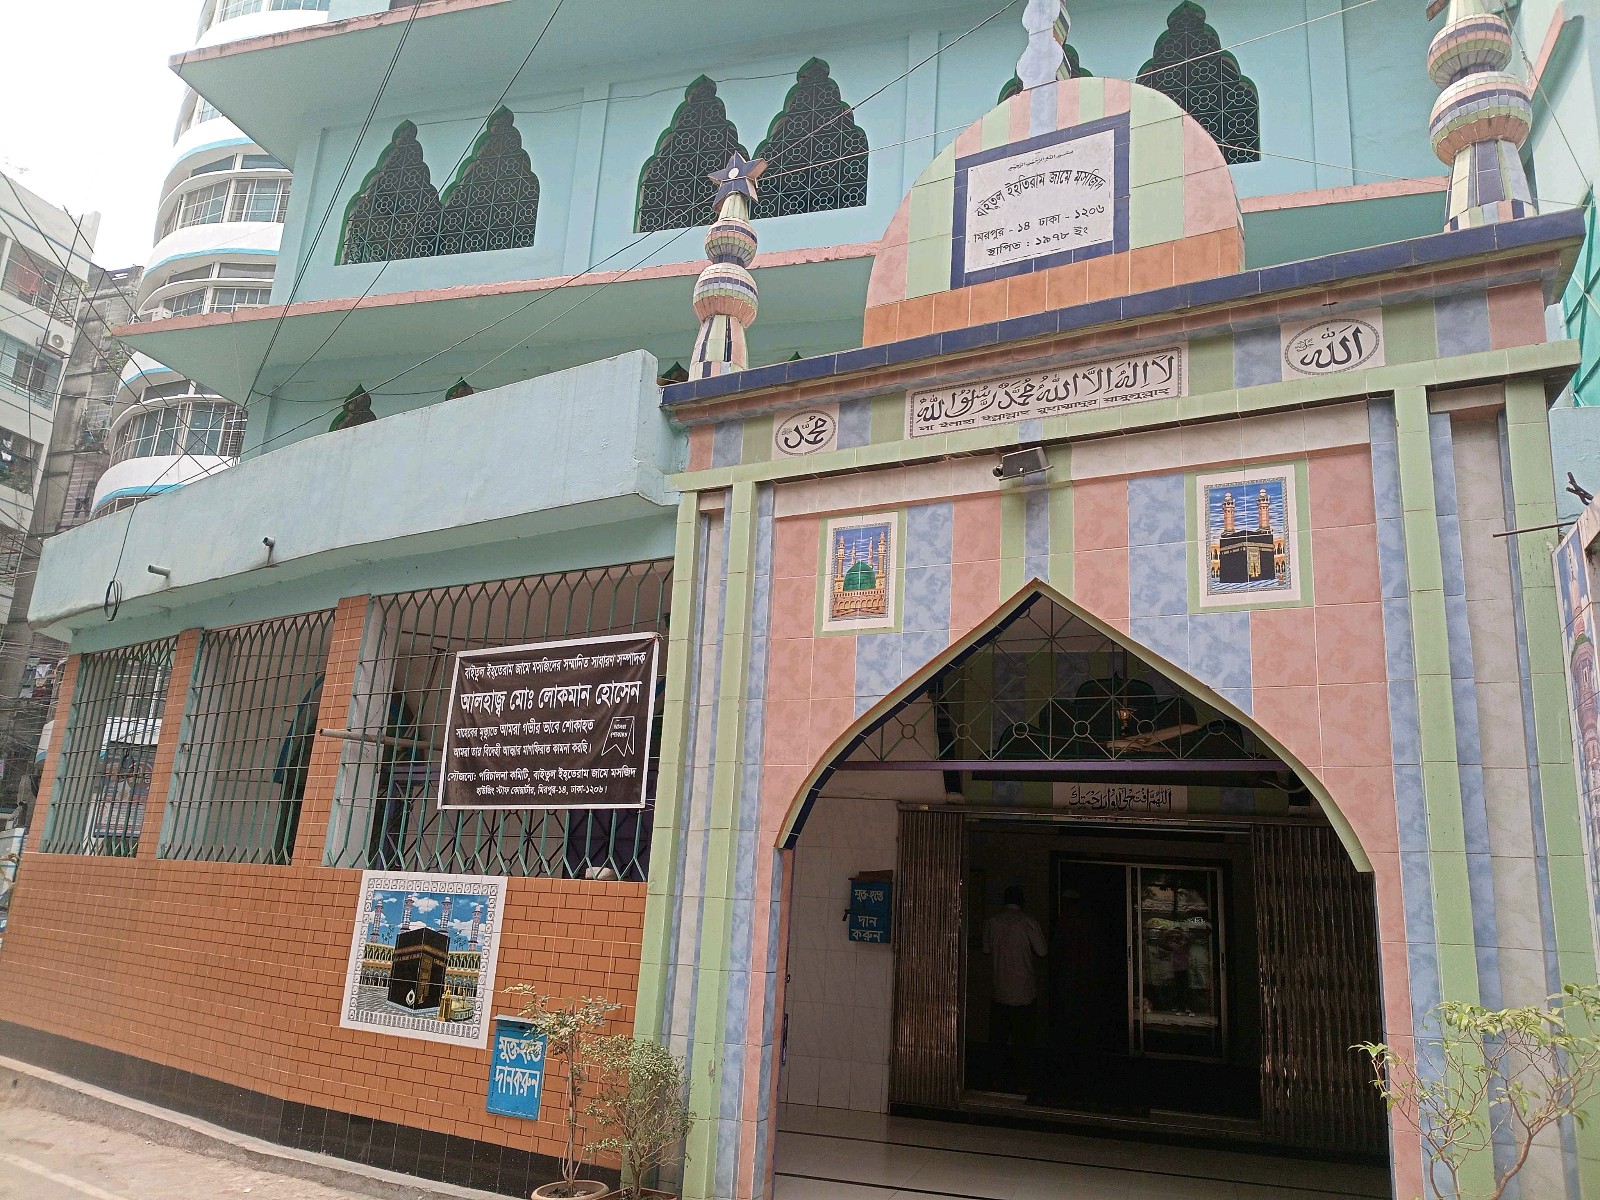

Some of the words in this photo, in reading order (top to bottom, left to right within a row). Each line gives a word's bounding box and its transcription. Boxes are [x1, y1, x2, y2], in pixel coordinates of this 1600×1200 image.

[975, 190, 1005, 216] বাইতুল
[1049, 169, 1072, 185] জামে
[1074, 168, 1106, 191] মসজিদ
[974, 227, 1005, 243] মিরপুর
[1018, 221, 1030, 233] ১৪
[1038, 213, 1061, 226] ঢাকা
[1075, 204, 1105, 219] ১২০৬
[986, 241, 1022, 256] স্থাপিত
[1035, 232, 1070, 245] ১৯৭৮
[1073, 226, 1088, 237] ইং
[464, 664, 486, 682] বাইতুল
[515, 661, 532, 676] জামে
[532, 656, 563, 674] মসজিদের
[562, 653, 590, 671] সম্মানিত
[590, 654, 616, 669] সাধারণ
[617, 651, 647, 667] সম্পাদক
[460, 688, 507, 718] আলহাজ্ব
[509, 686, 535, 711] মোঃ
[538, 682, 593, 709] লোকমান
[595, 680, 643, 708] হোসেন
[455, 727, 479, 739] সাহেবের
[499, 722, 521, 737] আমরা
[522, 717, 542, 736] গভীর
[543, 720, 561, 734] ভাবে
[562, 718, 596, 734] শোকাহত
[453, 746, 470, 758] আমরা
[483, 742, 502, 757] বিদেহী
[523, 741, 552, 756] মাগফিরাত
[552, 743, 571, 755] কামনা
[479, 768, 508, 782] পরিচালনা
[533, 767, 557, 782] বাইতুল
[590, 768, 609, 779] জামে
[610, 764, 637, 779] মসজিদ
[858, 915, 878, 928] দান
[851, 928, 884, 942] করুন
